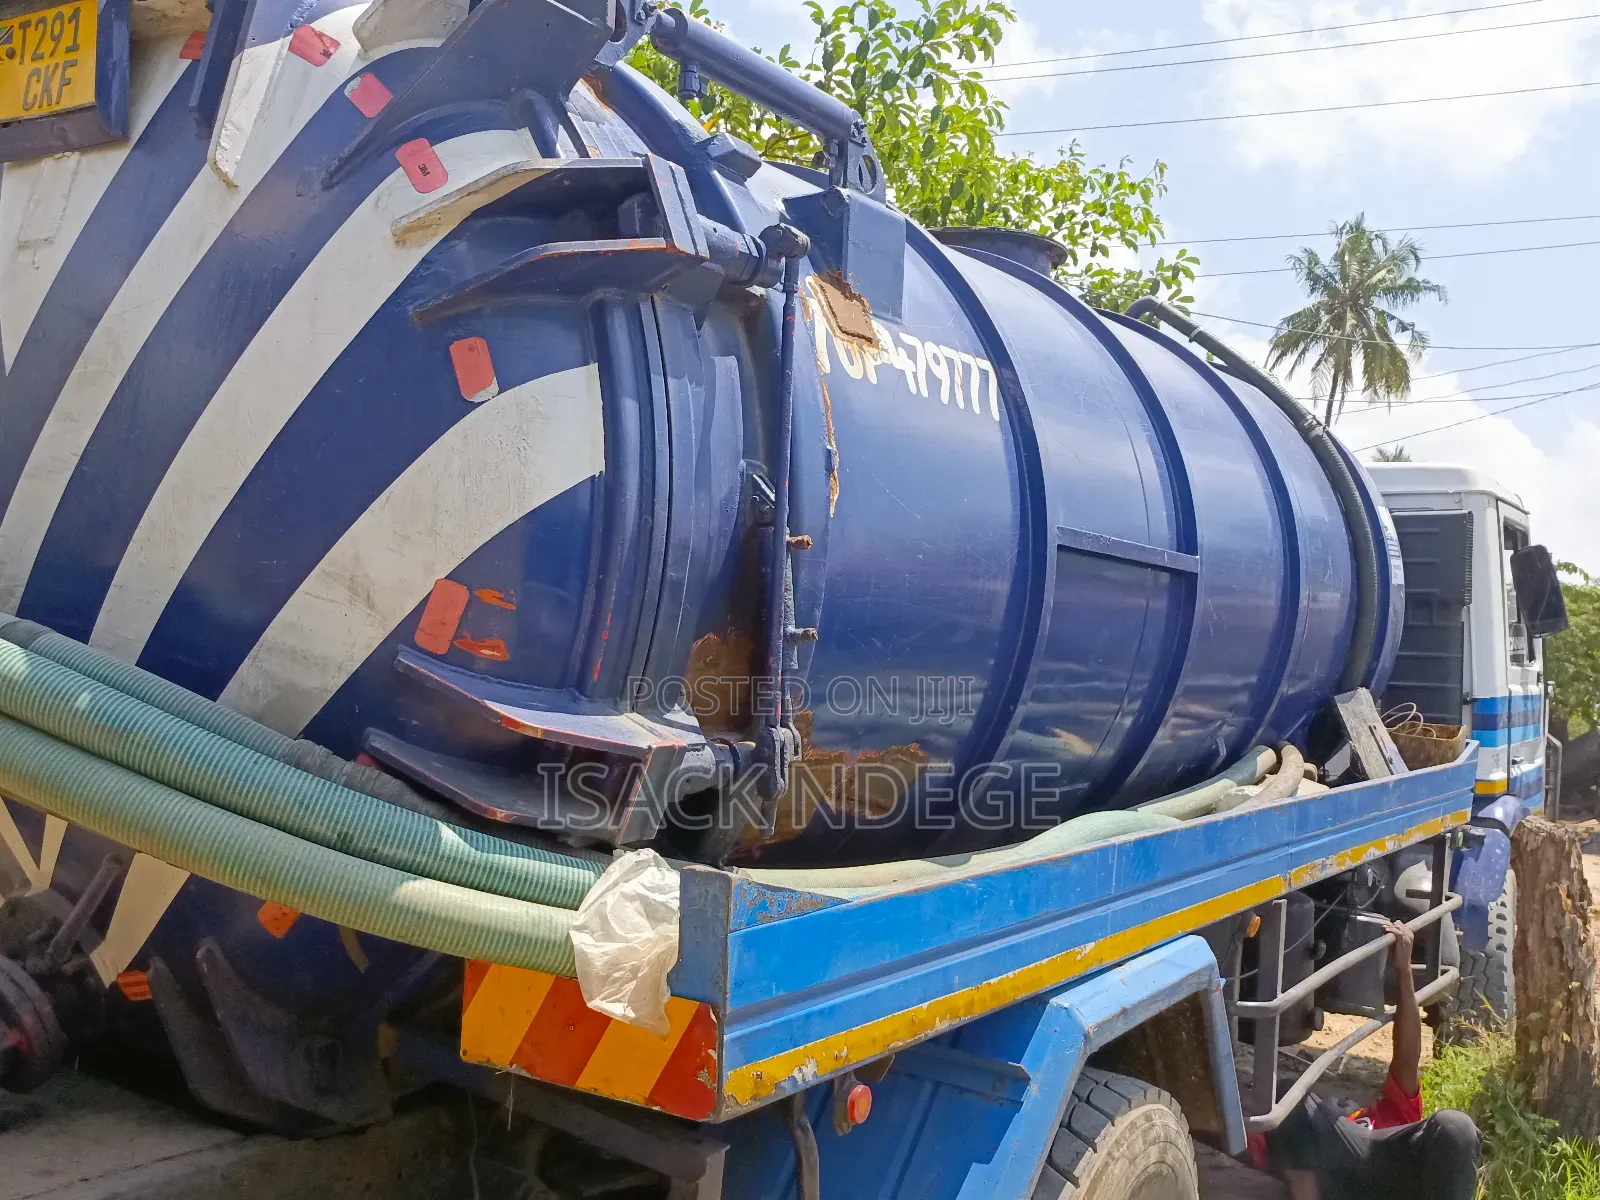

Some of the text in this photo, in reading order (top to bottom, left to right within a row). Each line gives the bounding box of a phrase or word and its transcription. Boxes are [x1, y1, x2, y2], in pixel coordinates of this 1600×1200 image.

[19, 7, 81, 65] T291
[22, 59, 78, 111] CKF
[418, 163, 430, 176] 3M
